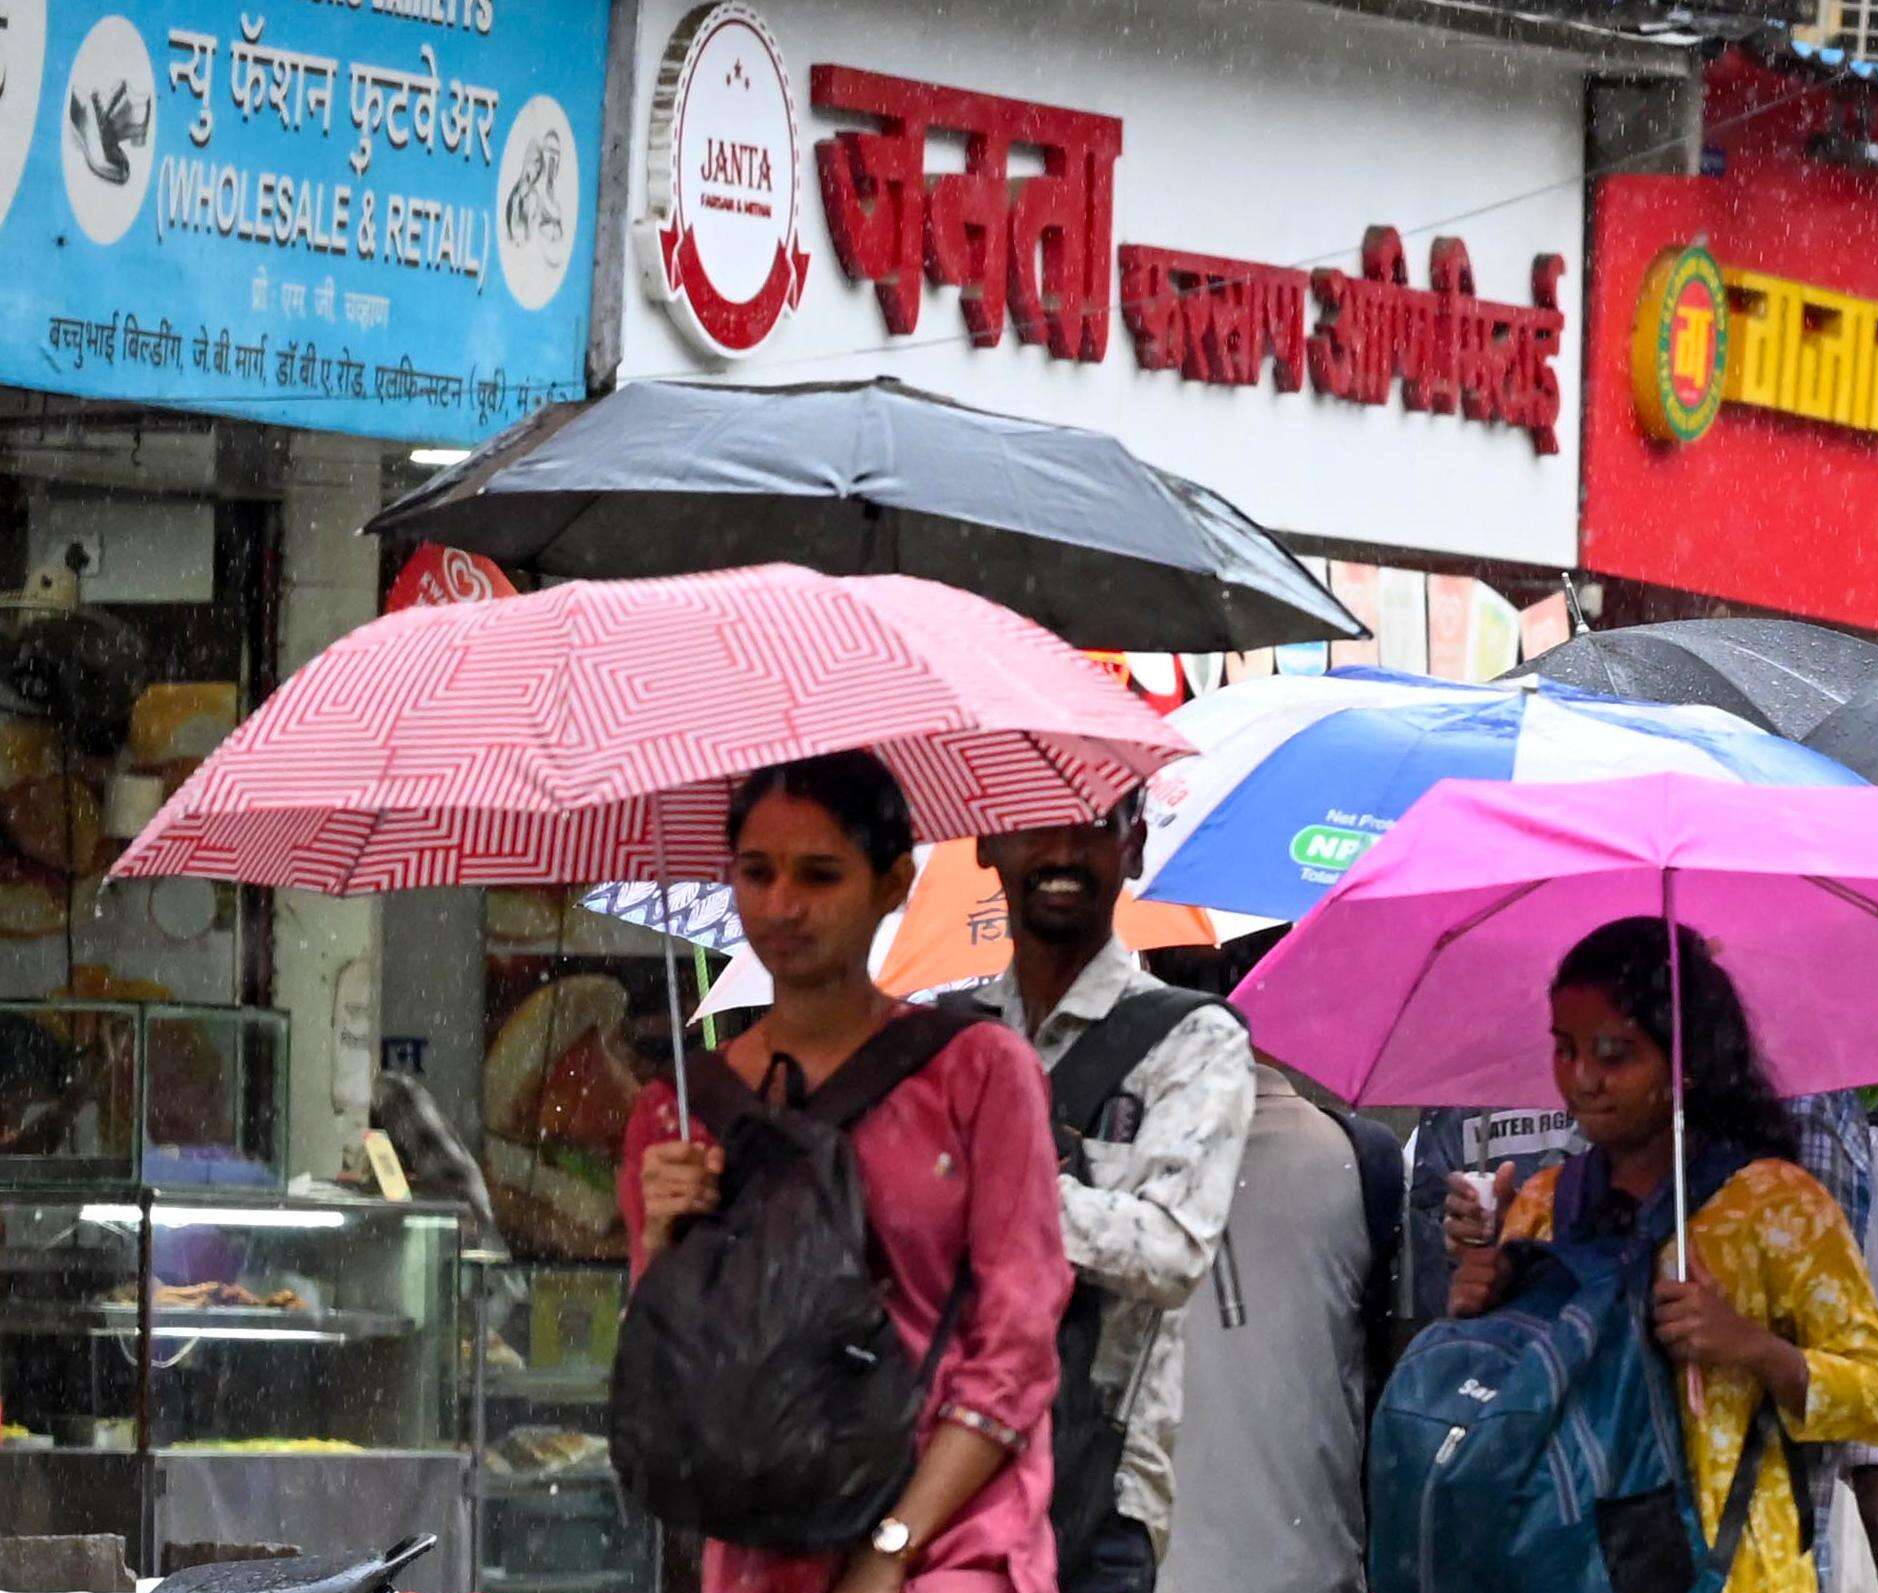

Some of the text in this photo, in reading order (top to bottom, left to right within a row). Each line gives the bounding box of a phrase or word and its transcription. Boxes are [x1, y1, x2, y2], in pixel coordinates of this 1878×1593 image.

[157, 154, 490, 297] (WHOLESALE & RETAIL)
[700, 137, 773, 192] JANTA
[810, 64, 1122, 363] जनता
[1118, 242, 1310, 393] फरसाण
[1305, 834, 1361, 860] NP
